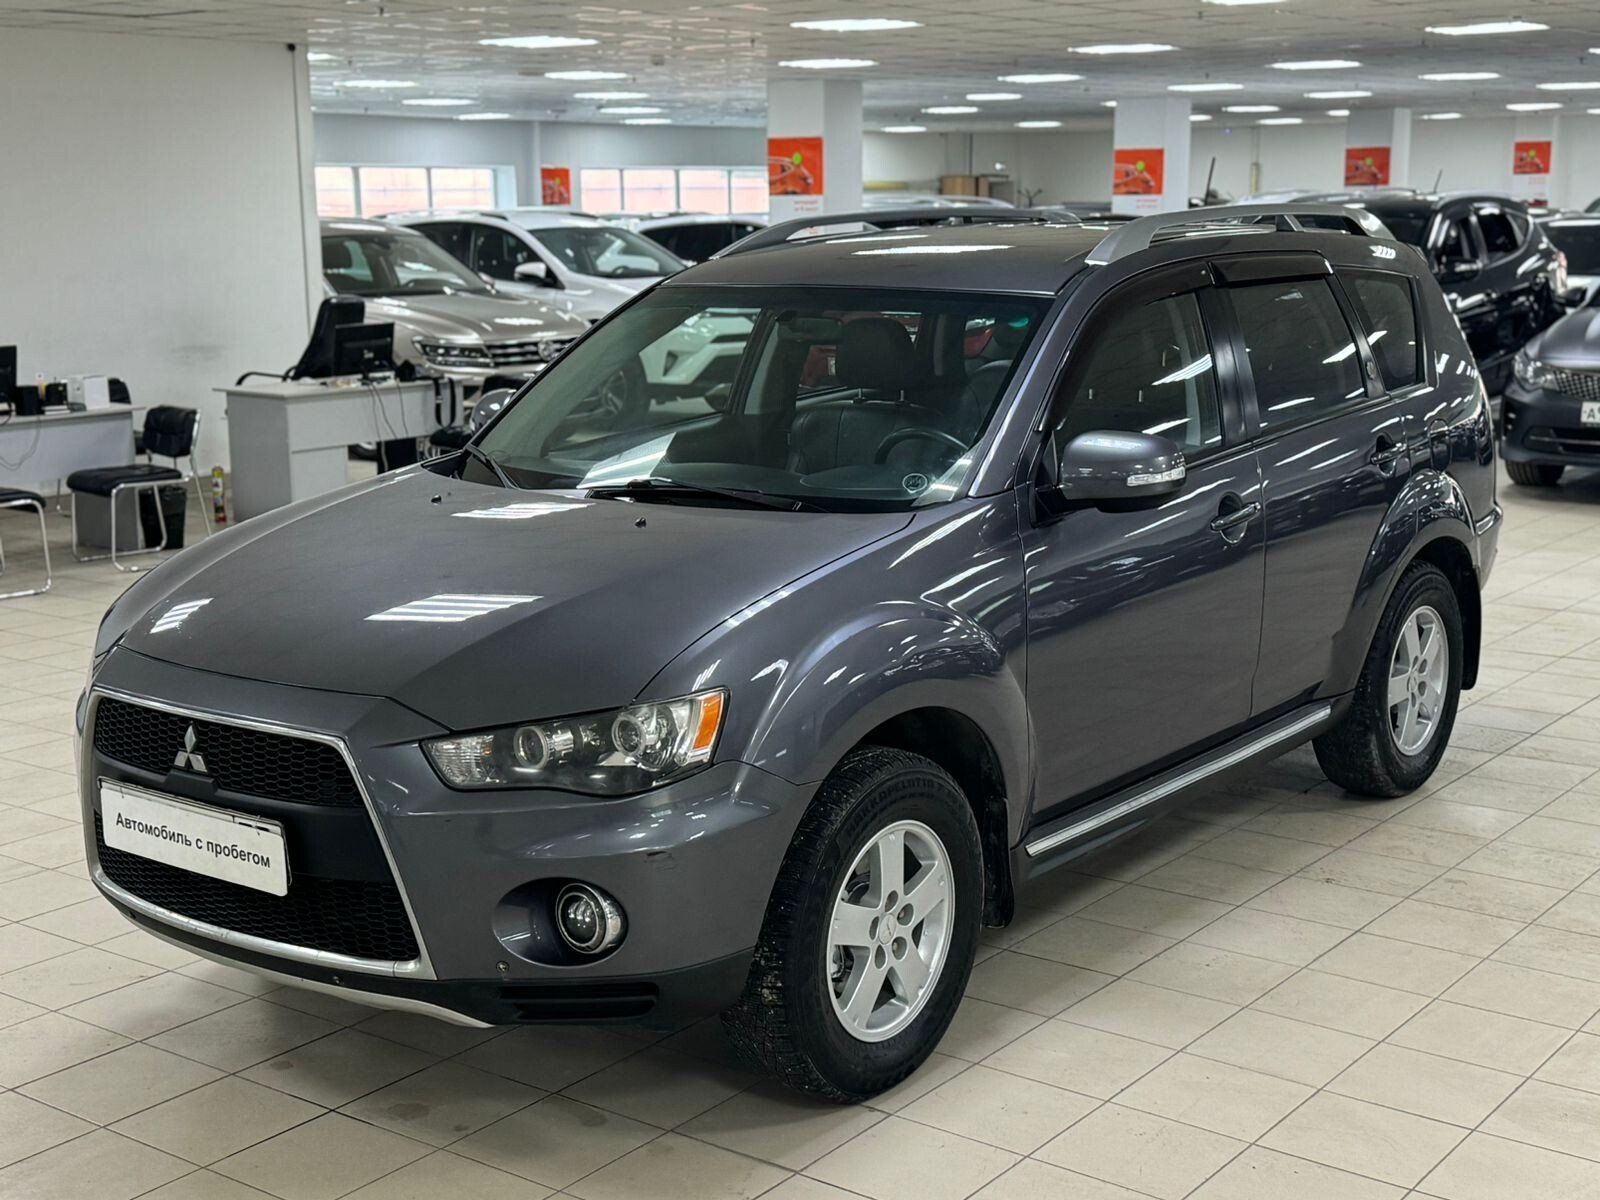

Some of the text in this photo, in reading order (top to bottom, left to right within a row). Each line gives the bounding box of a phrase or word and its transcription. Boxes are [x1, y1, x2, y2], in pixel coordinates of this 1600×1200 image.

[115, 812, 271, 868] Автомобиль с пробегом
